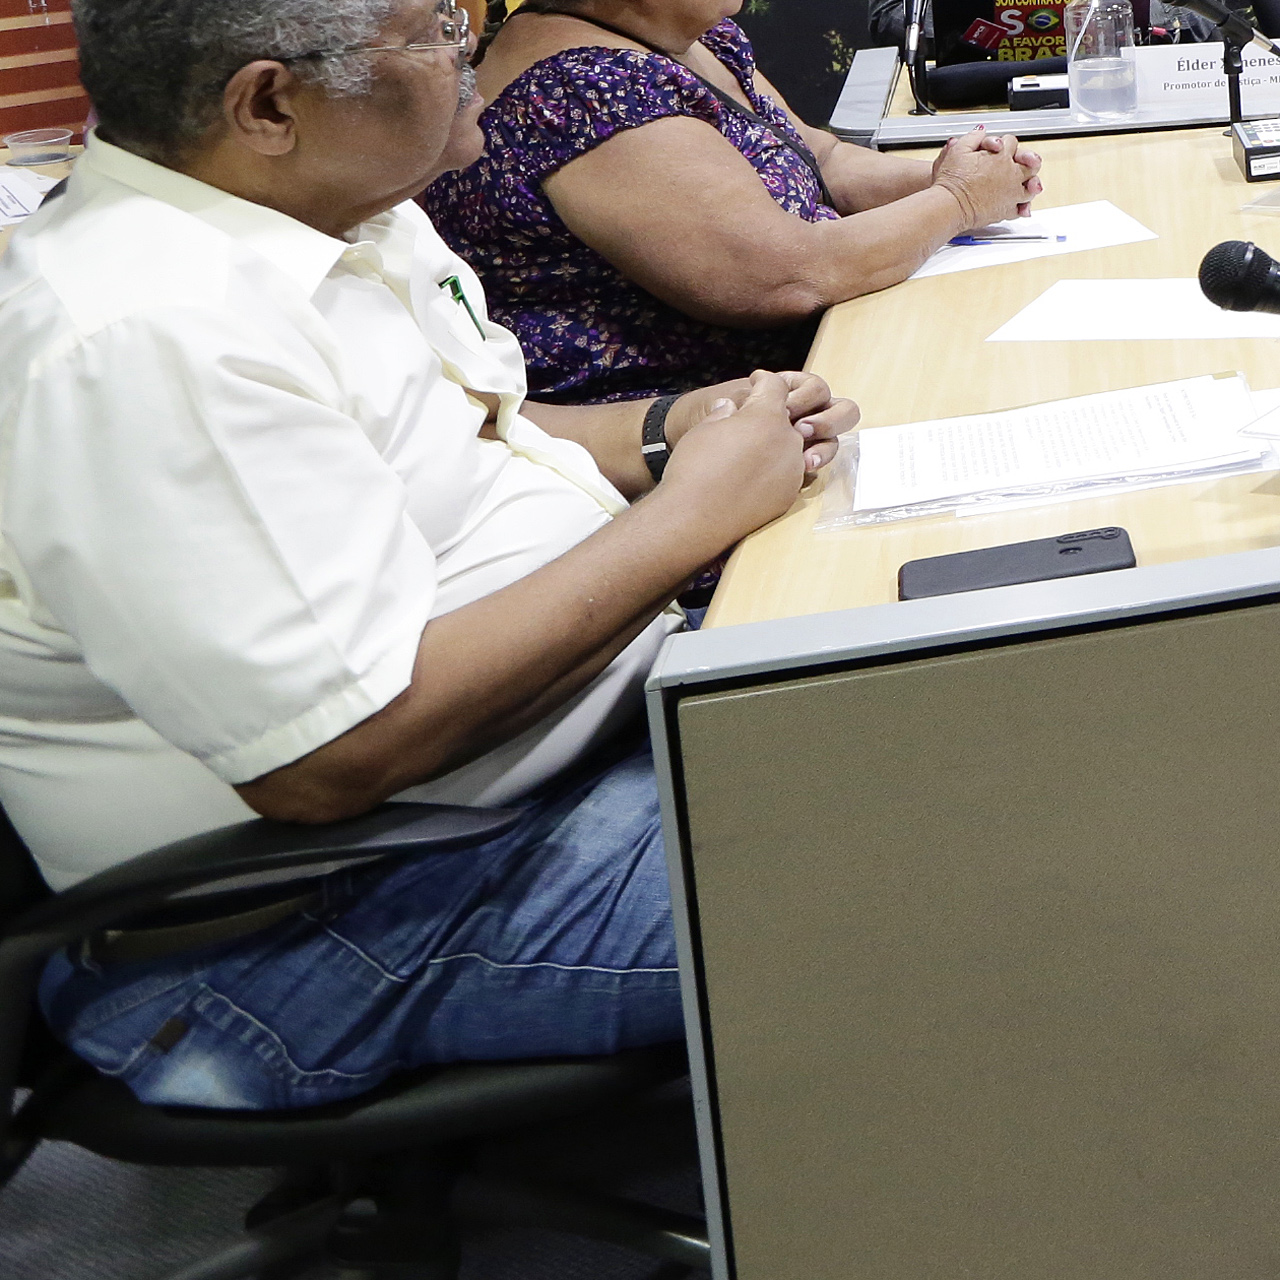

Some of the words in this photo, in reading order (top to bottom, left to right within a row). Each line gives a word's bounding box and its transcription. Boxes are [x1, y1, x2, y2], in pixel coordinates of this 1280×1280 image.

[1013, 36, 1065, 47] FAVOR
[1177, 57, 1216, 72] Élder
[1163, 81, 1210, 91] Promotor
[1214, 79, 1226, 87] de
